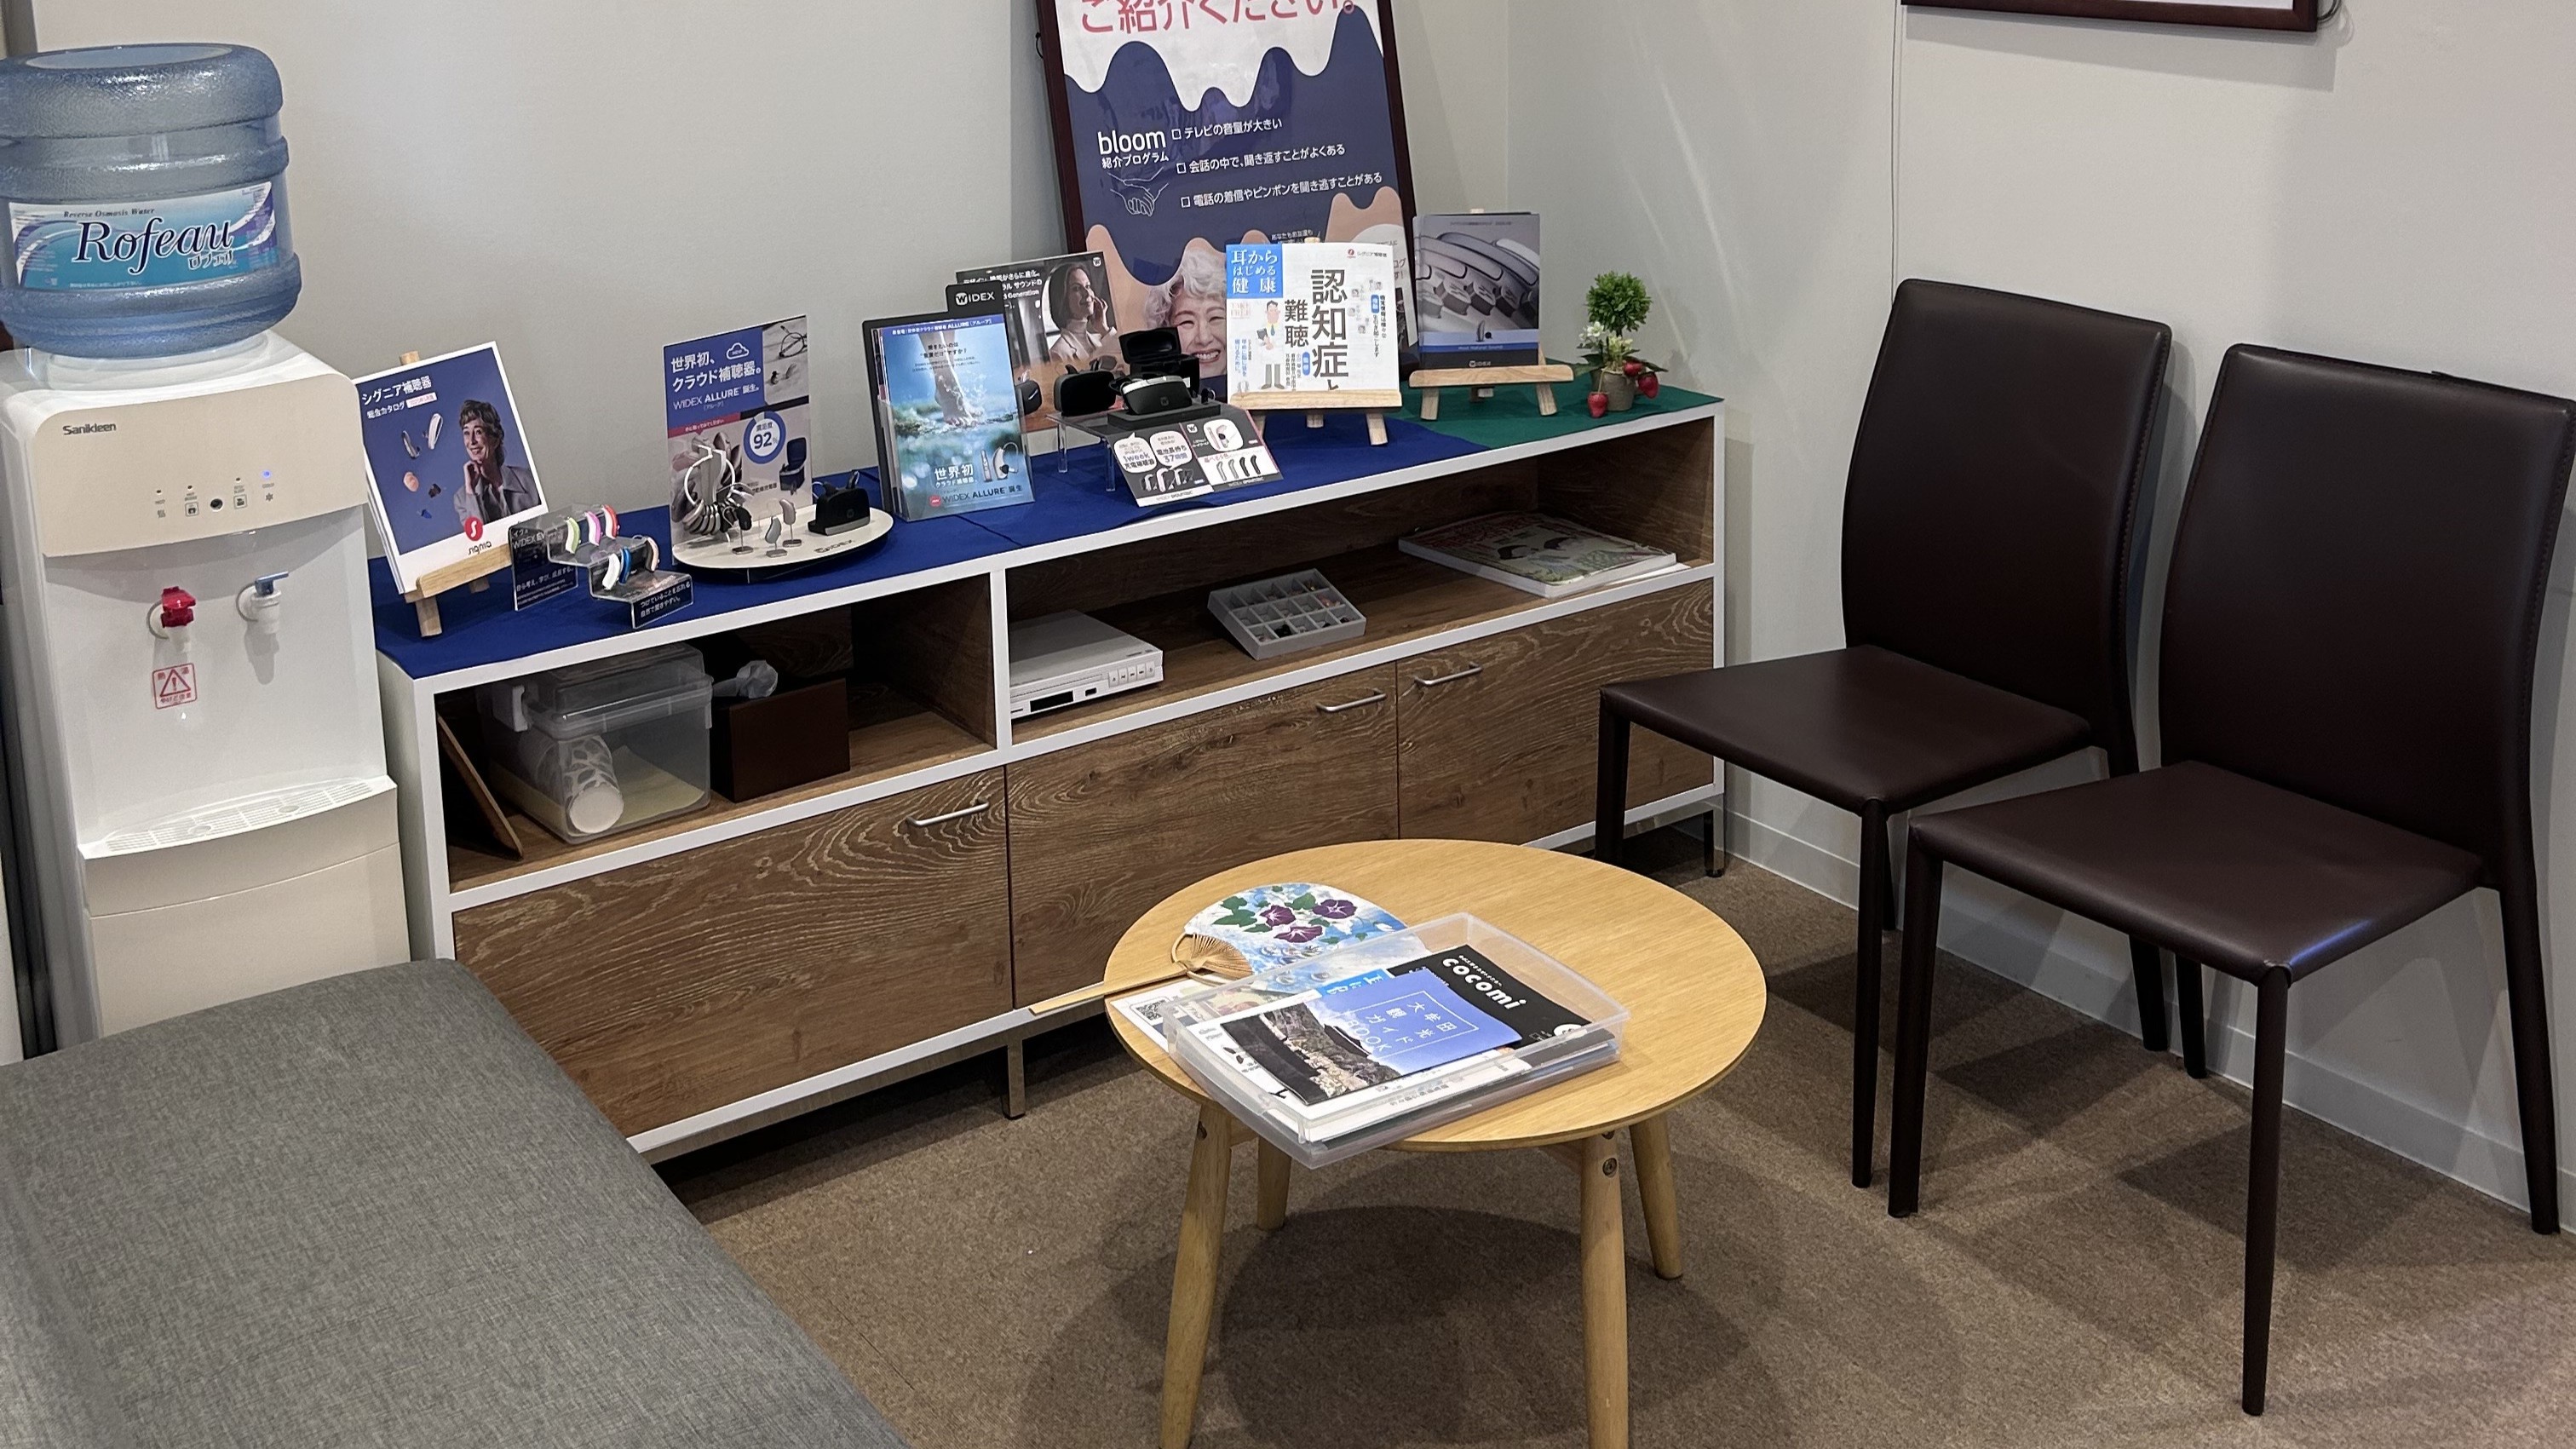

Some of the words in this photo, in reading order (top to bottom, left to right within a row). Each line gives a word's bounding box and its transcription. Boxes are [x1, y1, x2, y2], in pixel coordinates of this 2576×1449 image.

[1184, 118, 1283, 140] テレビの音量が大きい
[1098, 129, 1166, 155] bloom
[1101, 152, 1170, 170] 紹介プログラム
[1189, 143, 1346, 174] 会話の中で、聞き返すことがよくある
[95, 209, 129, 217] Osmosis
[72, 216, 234, 275] Rofeau
[1231, 250, 1278, 265] 耳から
[1233, 266, 1276, 277] はじめる
[955, 291, 995, 306] WIDEX
[1284, 299, 1309, 348] 難聴
[671, 351, 715, 373] 世界初、
[673, 360, 762, 393] クラウド補聴器。
[361, 375, 431, 405] シグニア補聴器
[673, 396, 703, 410] WIDEX
[704, 388, 739, 403] ALLURE
[62, 423, 117, 435] Sanikleen
[934, 463, 973, 480] 世界初
[972, 486, 1005, 498] ALLURE
[1442, 957, 1527, 1010] cocomi
[1346, 1019, 1393, 1052] BOOK
